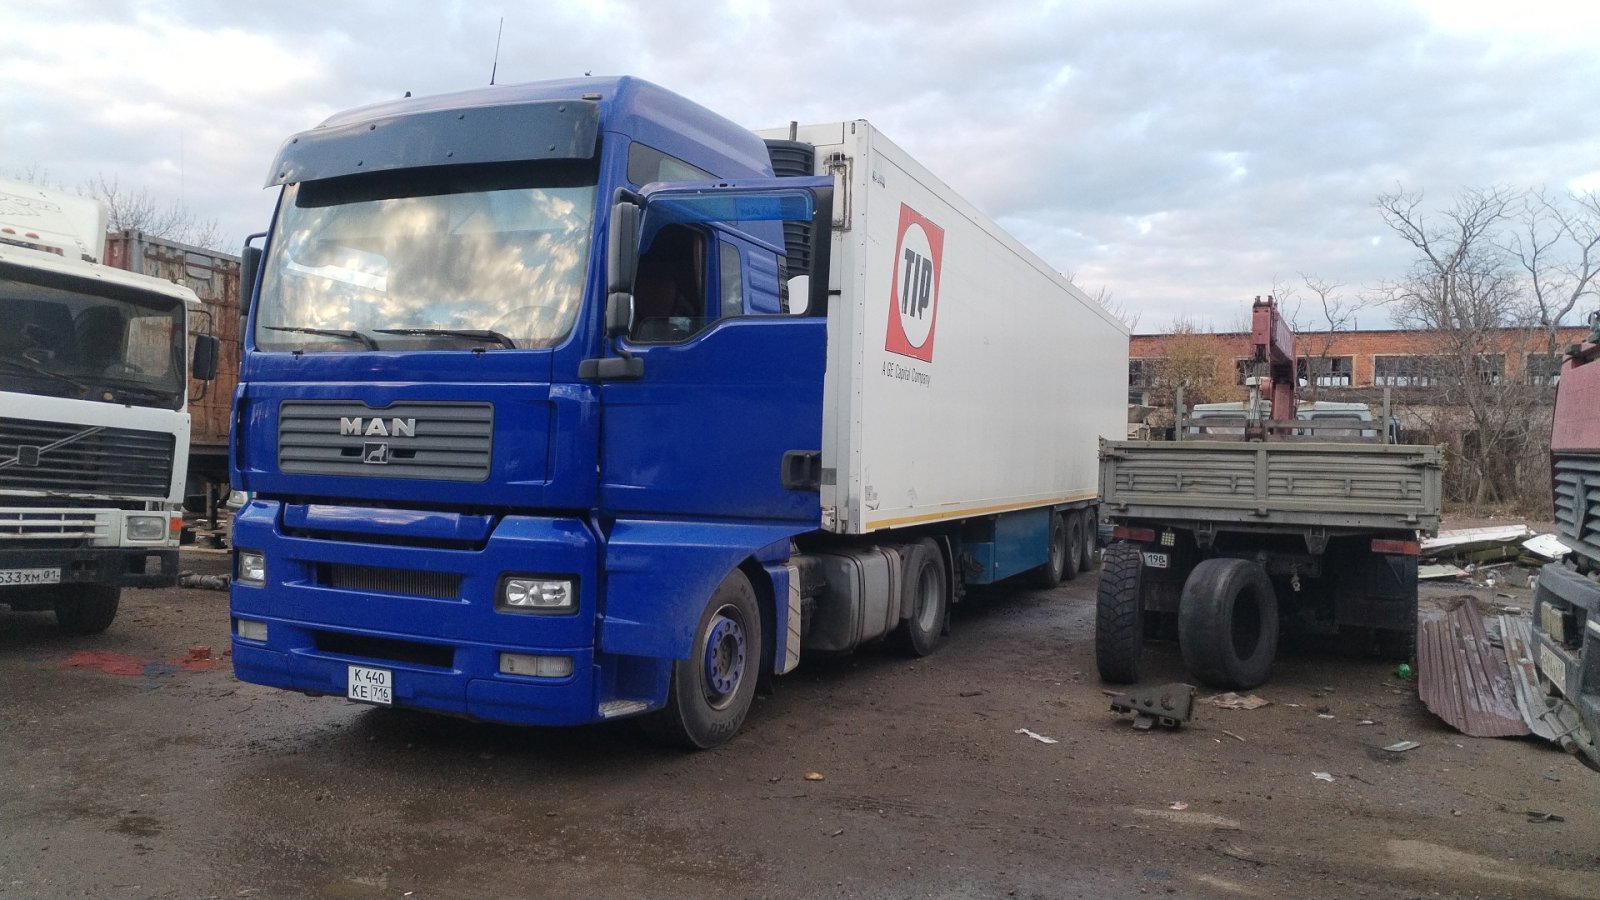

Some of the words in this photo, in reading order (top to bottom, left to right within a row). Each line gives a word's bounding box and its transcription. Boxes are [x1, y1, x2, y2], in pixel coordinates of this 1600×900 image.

[901, 247, 933, 321] TIP
[881, 361, 886, 376] A
[887, 362, 894, 378] GE
[895, 364, 911, 381] Capital
[911, 368, 931, 388] Company
[340, 417, 416, 437] MAN
[355, 669, 361, 681] К
[366, 671, 384, 684] 440
[352, 684, 367, 698] КЕ
[373, 686, 388, 698] 716
